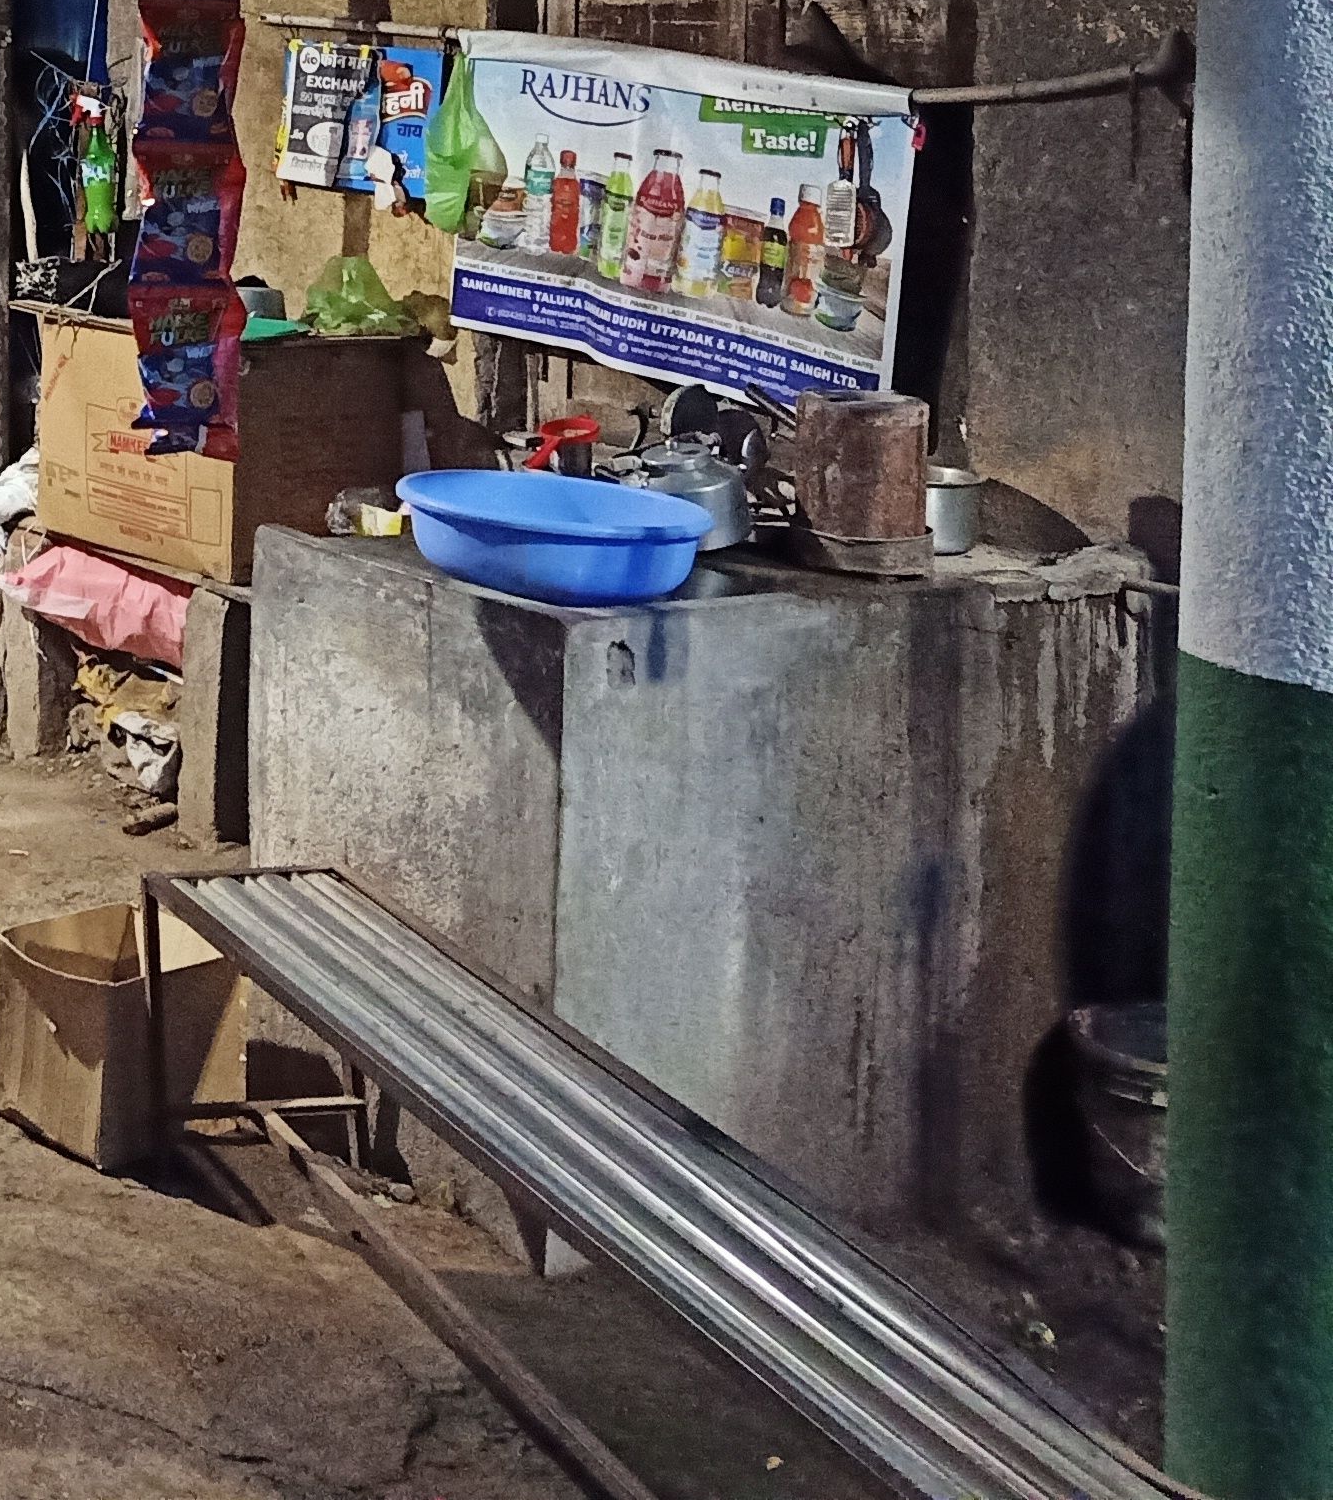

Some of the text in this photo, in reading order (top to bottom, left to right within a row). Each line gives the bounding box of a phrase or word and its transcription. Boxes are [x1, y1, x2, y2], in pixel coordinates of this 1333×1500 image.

[302, 56, 317, 66] Jio
[306, 75, 366, 93] EXCHANG
[520, 68, 652, 113] RAJHANS
[749, 127, 817, 152] Taste!
[461, 277, 532, 300] SANGAMNER
[534, 290, 583, 309] TALUKA
[612, 311, 647, 331] DUDH
[650, 319, 715, 348] UTPADAK
[716, 337, 727, 350] &
[728, 341, 787, 369] PRAKRIYA
[790, 358, 831, 382] SANGH
[832, 372, 862, 390] LTD.
[109, 433, 150, 450] NAMKEE
